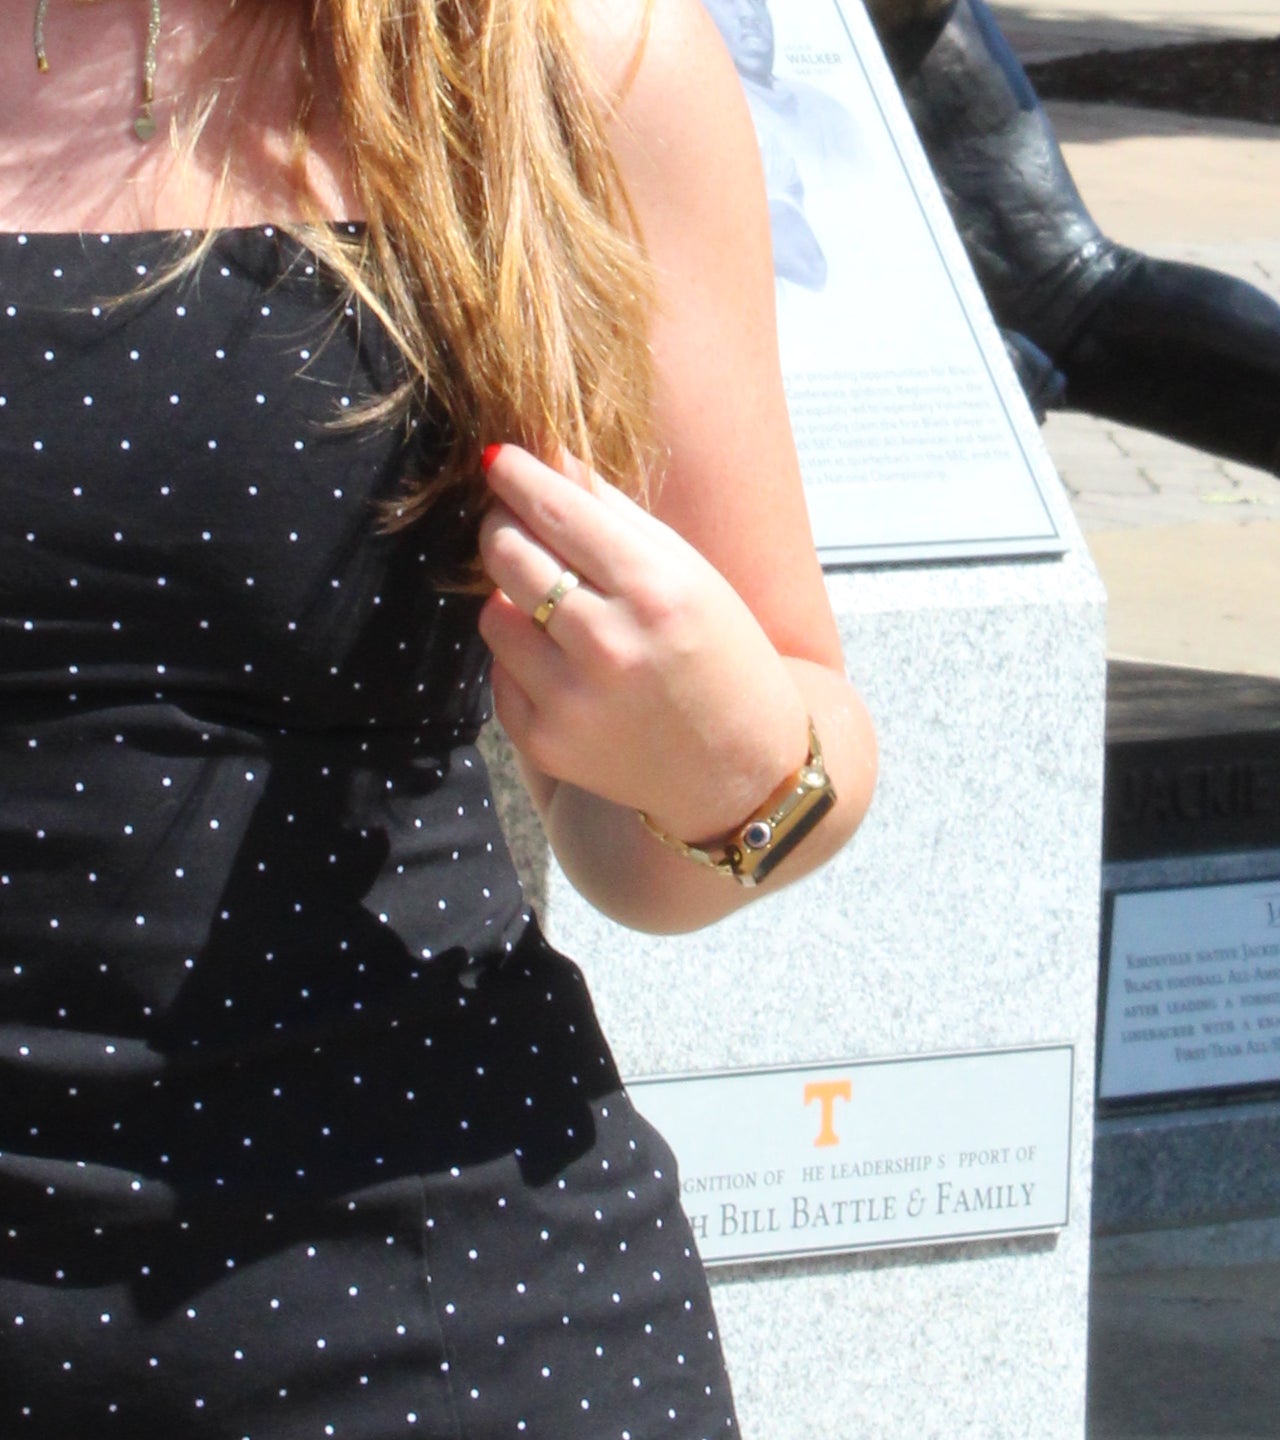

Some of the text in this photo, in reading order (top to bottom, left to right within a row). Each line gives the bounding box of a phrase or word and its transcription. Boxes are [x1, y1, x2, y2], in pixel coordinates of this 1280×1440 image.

[681, 1171, 757, 1194] GNITION
[763, 1169, 785, 1187] OF
[831, 1155, 932, 1180] LEADERSHIP
[1016, 1145, 1037, 1162] OF
